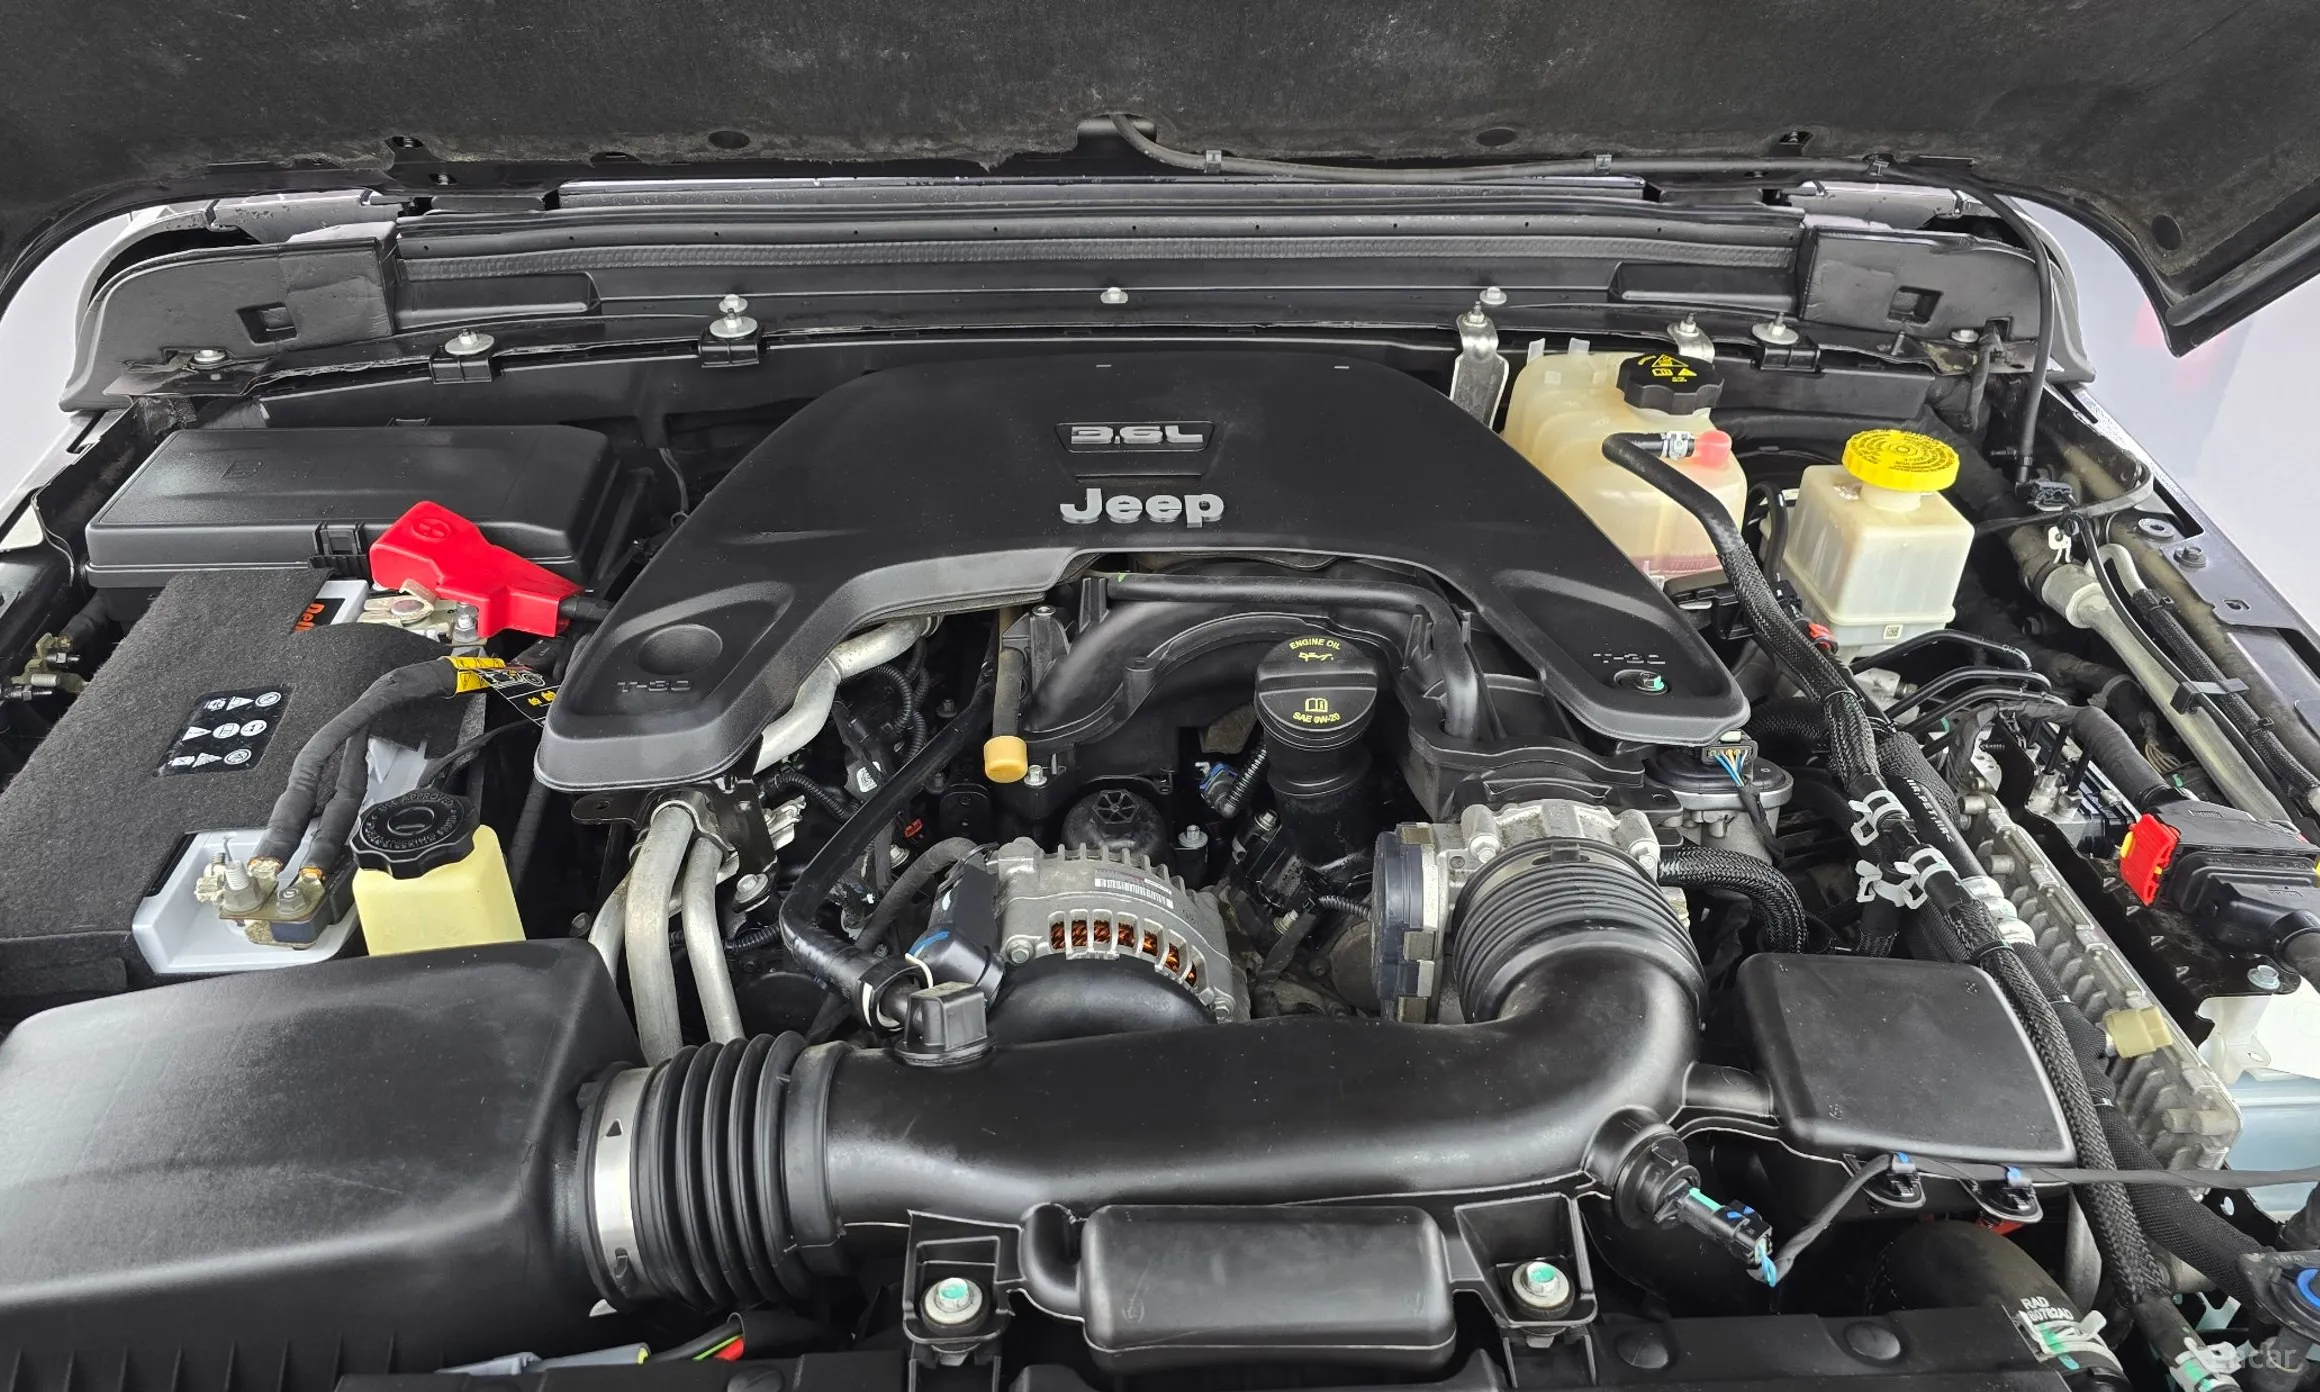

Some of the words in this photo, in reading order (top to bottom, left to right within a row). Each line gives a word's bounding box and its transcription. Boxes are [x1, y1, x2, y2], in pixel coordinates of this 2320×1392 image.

[1071, 425, 1203, 444] 3.6L
[1060, 488, 1224, 528] Jeep
[1289, 638, 1325, 650] ENGINE
[1326, 641, 1341, 650] OIL
[1292, 711, 1312, 723] SAE
[1313, 712, 1340, 724] 0W-20
[2020, 1296, 2050, 1310] RAD
